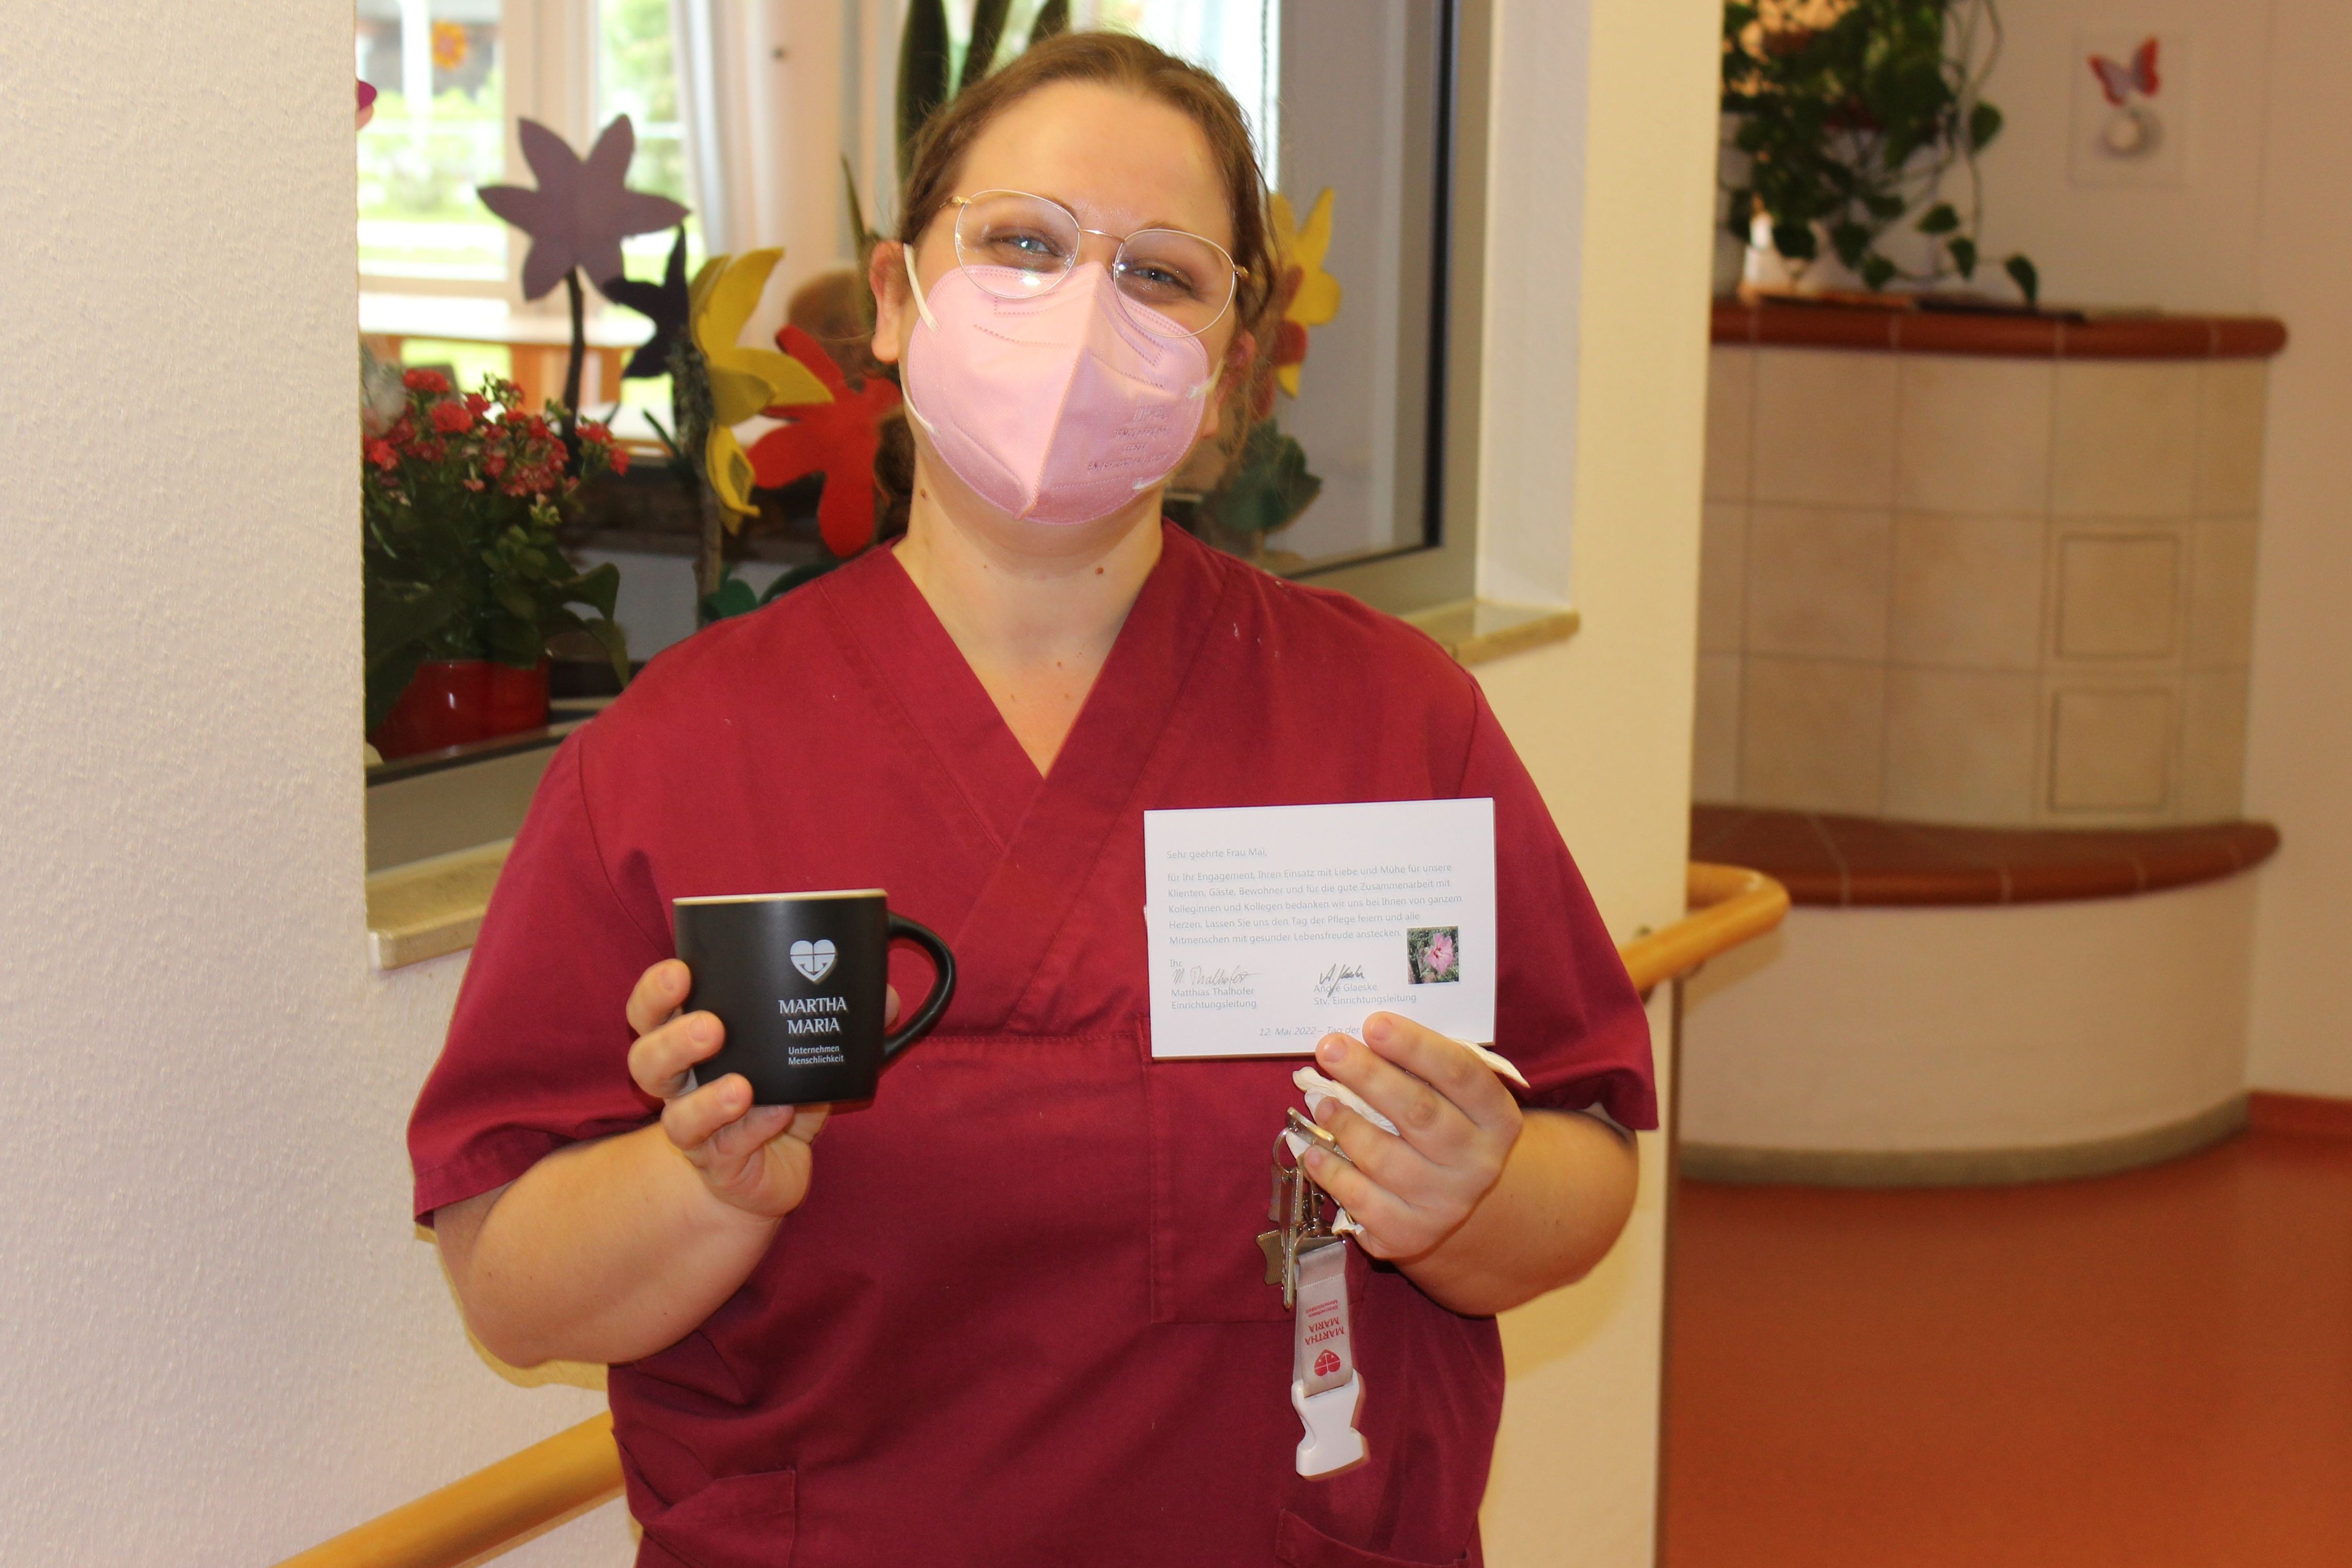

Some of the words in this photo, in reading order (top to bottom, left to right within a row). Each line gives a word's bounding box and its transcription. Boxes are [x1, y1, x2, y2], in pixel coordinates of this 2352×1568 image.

[1167, 850, 1185, 859] Sehr
[1189, 849, 1223, 860] geehrte
[1227, 849, 1245, 857] Frau
[1249, 848, 1267, 857] Mai,
[1167, 874, 1180, 882] für
[1182, 873, 1195, 881] Ihr
[1198, 871, 1255, 882] Engagement,
[1258, 871, 1281, 879] Ihren
[1284, 869, 1314, 878] Einsatz
[1334, 867, 1357, 876] Liebe
[1360, 866, 1377, 875] und
[1380, 865, 1405, 874] Mühe
[1408, 864, 1420, 873] für
[1423, 864, 1452, 872] unsere
[1168, 889, 1206, 898] Klienten,
[1209, 888, 1236, 897] Gäste,
[1239, 887, 1282, 895] Bewohner
[1286, 885, 1303, 894] und
[1306, 884, 1319, 893] für
[1321, 884, 1335, 892] die
[1337, 883, 1357, 893] gute
[1360, 880, 1433, 891] Zusammenarbeit
[1168, 905, 1220, 914] Kolleginnen
[1244, 902, 1282, 912] Kollegen
[1285, 900, 1328, 909] bedanken
[1382, 897, 1406, 906] Ihnen
[1428, 896, 1461, 905] ganzem
[1169, 921, 1202, 929] Herzen.
[1205, 919, 1234, 928] Lassen
[1238, 918, 1250, 927] Sie
[1271, 917, 1288, 925] den
[1291, 916, 1307, 926] Tag
[1327, 915, 1355, 925] Pflege
[1358, 914, 1382, 922] feiern
[1170, 934, 1229, 944] Mitmenschen
[1250, 932, 1290, 943] gesunder
[1294, 930, 1353, 940] Lebensfreude
[1356, 929, 1401, 938] anstecken.
[1171, 988, 1209, 997] Matthias
[1213, 987, 1253, 996] Thalhofer
[1314, 983, 1340, 993] Andé
[1343, 983, 1377, 992] Glaeske
[778, 997, 847, 1014] MARTHA
[1172, 999, 1256, 1010] Einrichtungsleitung
[1333, 994, 1416, 1004] Einrichtungsleitung
[787, 1018, 840, 1034] MARIA
[1345, 1025, 1360, 1033] der
[788, 1045, 839, 1055] Unternehmen
[788, 1054, 844, 1065] Menschlichkeit
[1309, 1317, 1339, 1332] MARIA
[1305, 1326, 1344, 1345] MARTHA
